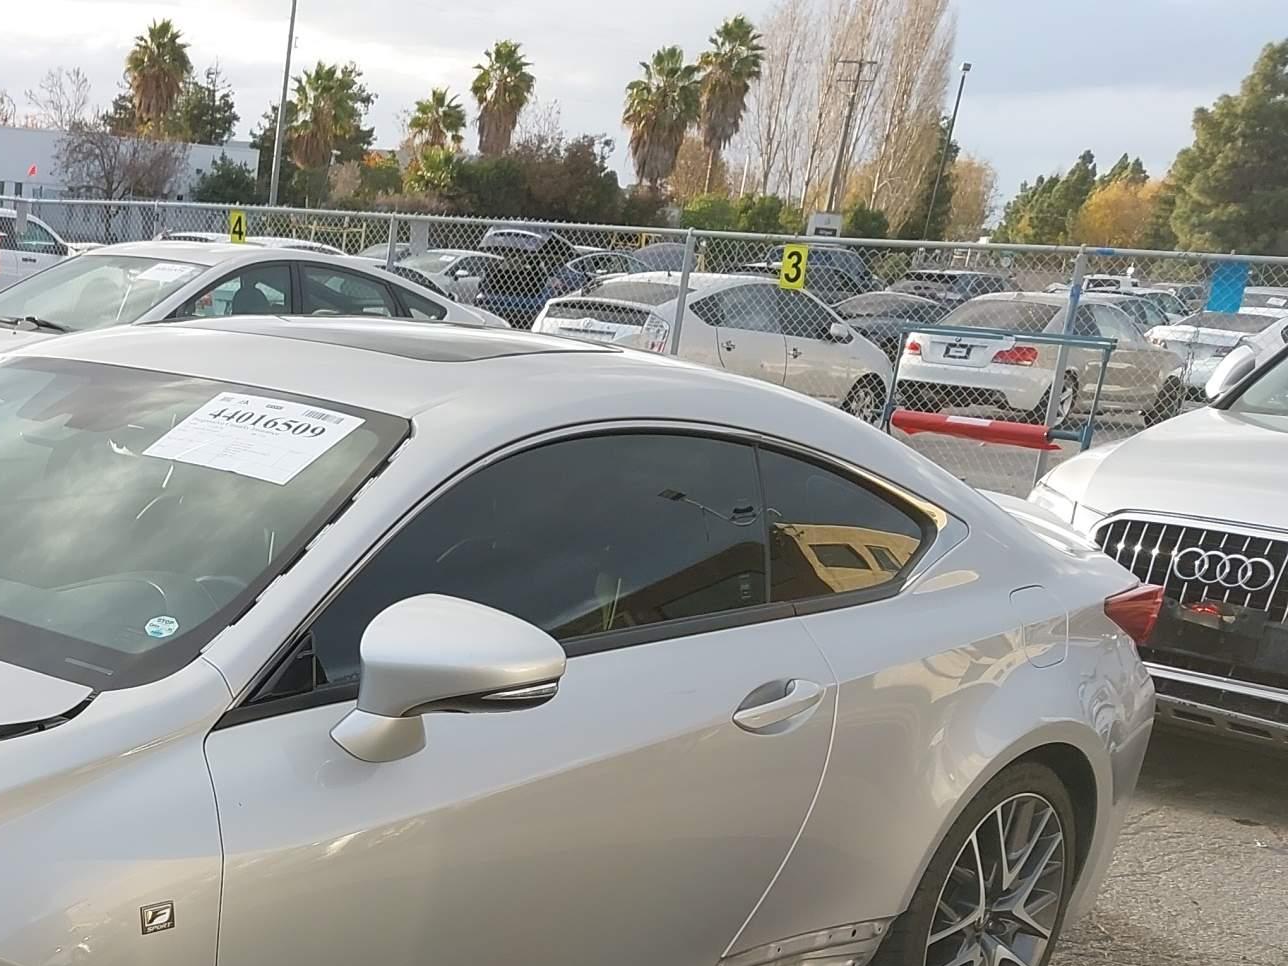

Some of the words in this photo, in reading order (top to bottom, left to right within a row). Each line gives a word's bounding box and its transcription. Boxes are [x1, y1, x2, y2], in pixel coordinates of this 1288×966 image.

[232, 215, 244, 240] 4
[784, 250, 803, 283] 3
[208, 407, 326, 439] 44016509
